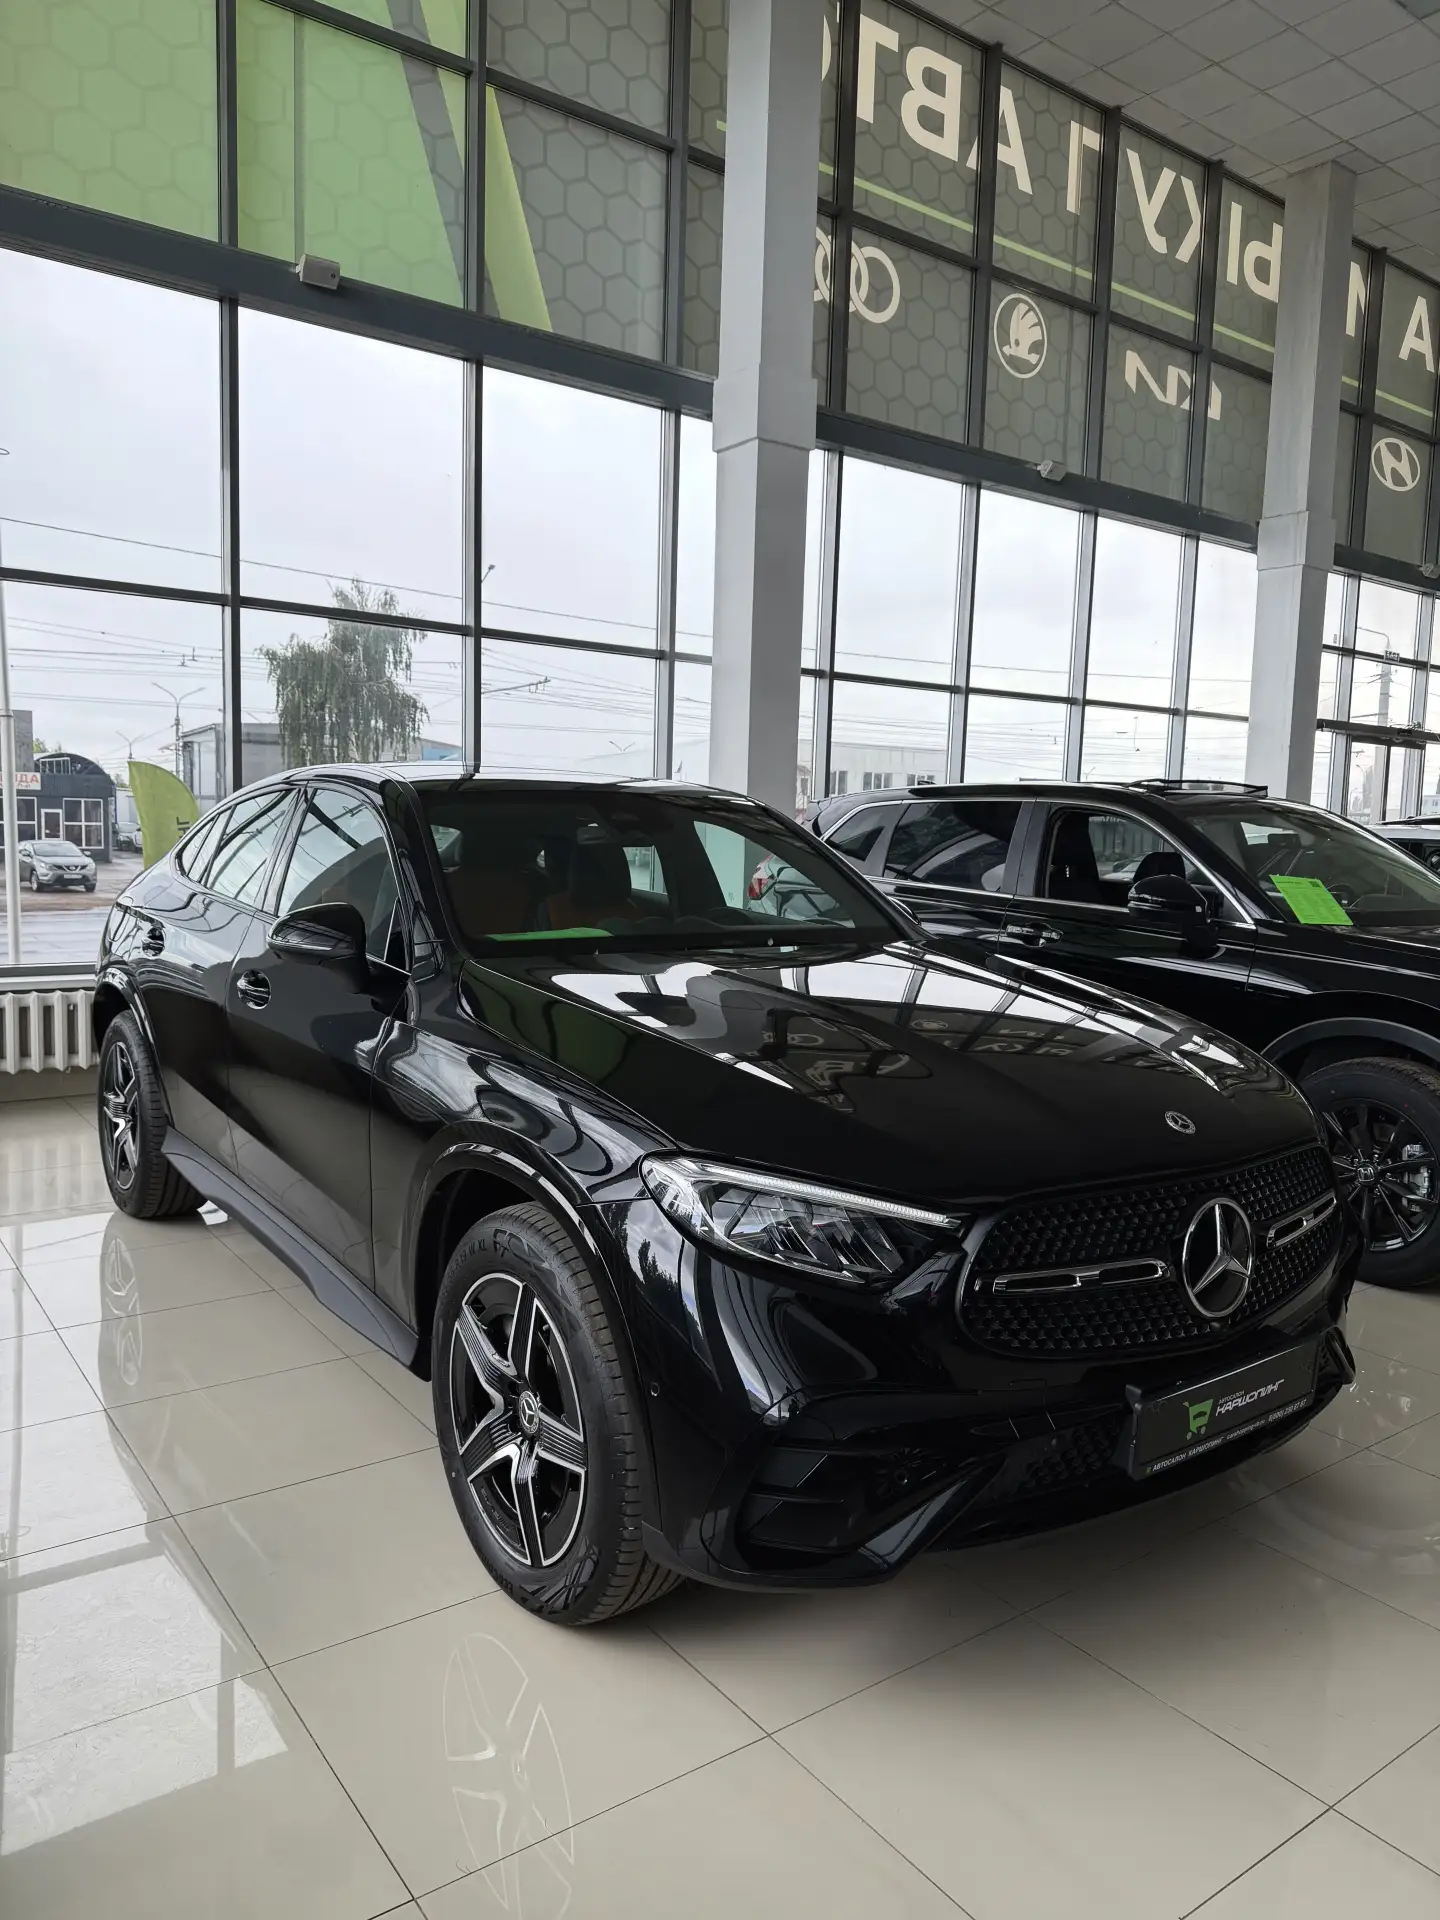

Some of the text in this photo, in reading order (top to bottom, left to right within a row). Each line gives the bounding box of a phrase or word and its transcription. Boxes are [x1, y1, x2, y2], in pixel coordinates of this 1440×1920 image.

[1215, 1379, 1285, 1417] КАРШОПИНГ
[1219, 1390, 1245, 1405] АВТОСАЛОН
[1152, 1453, 1187, 1472] АВТОСАЛОН
[1187, 1436, 1225, 1457] КАРШОПИНГ
